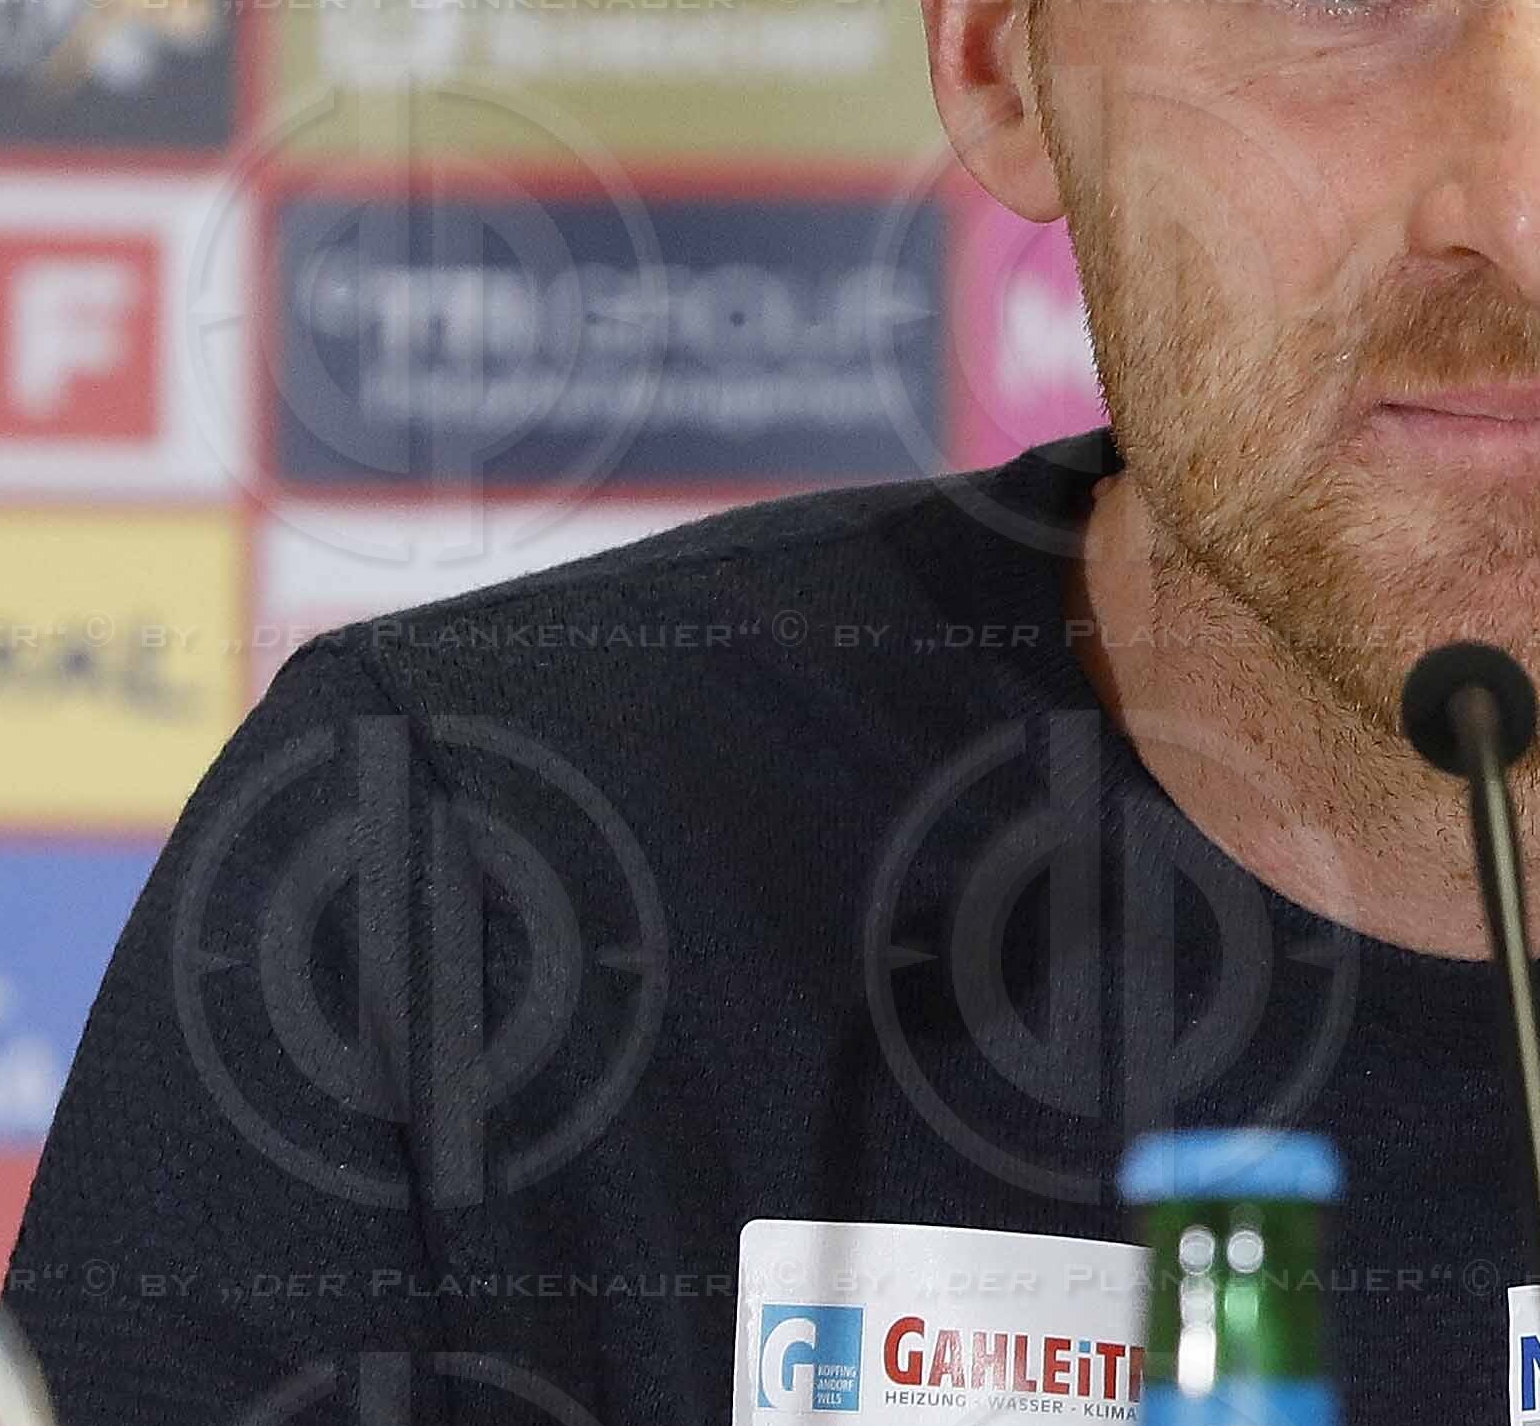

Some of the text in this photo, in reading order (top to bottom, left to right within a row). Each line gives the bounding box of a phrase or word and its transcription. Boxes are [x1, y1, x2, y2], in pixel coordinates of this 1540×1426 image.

[884, 1390, 1139, 1423] HEIZUNG WASSER KLIMA
